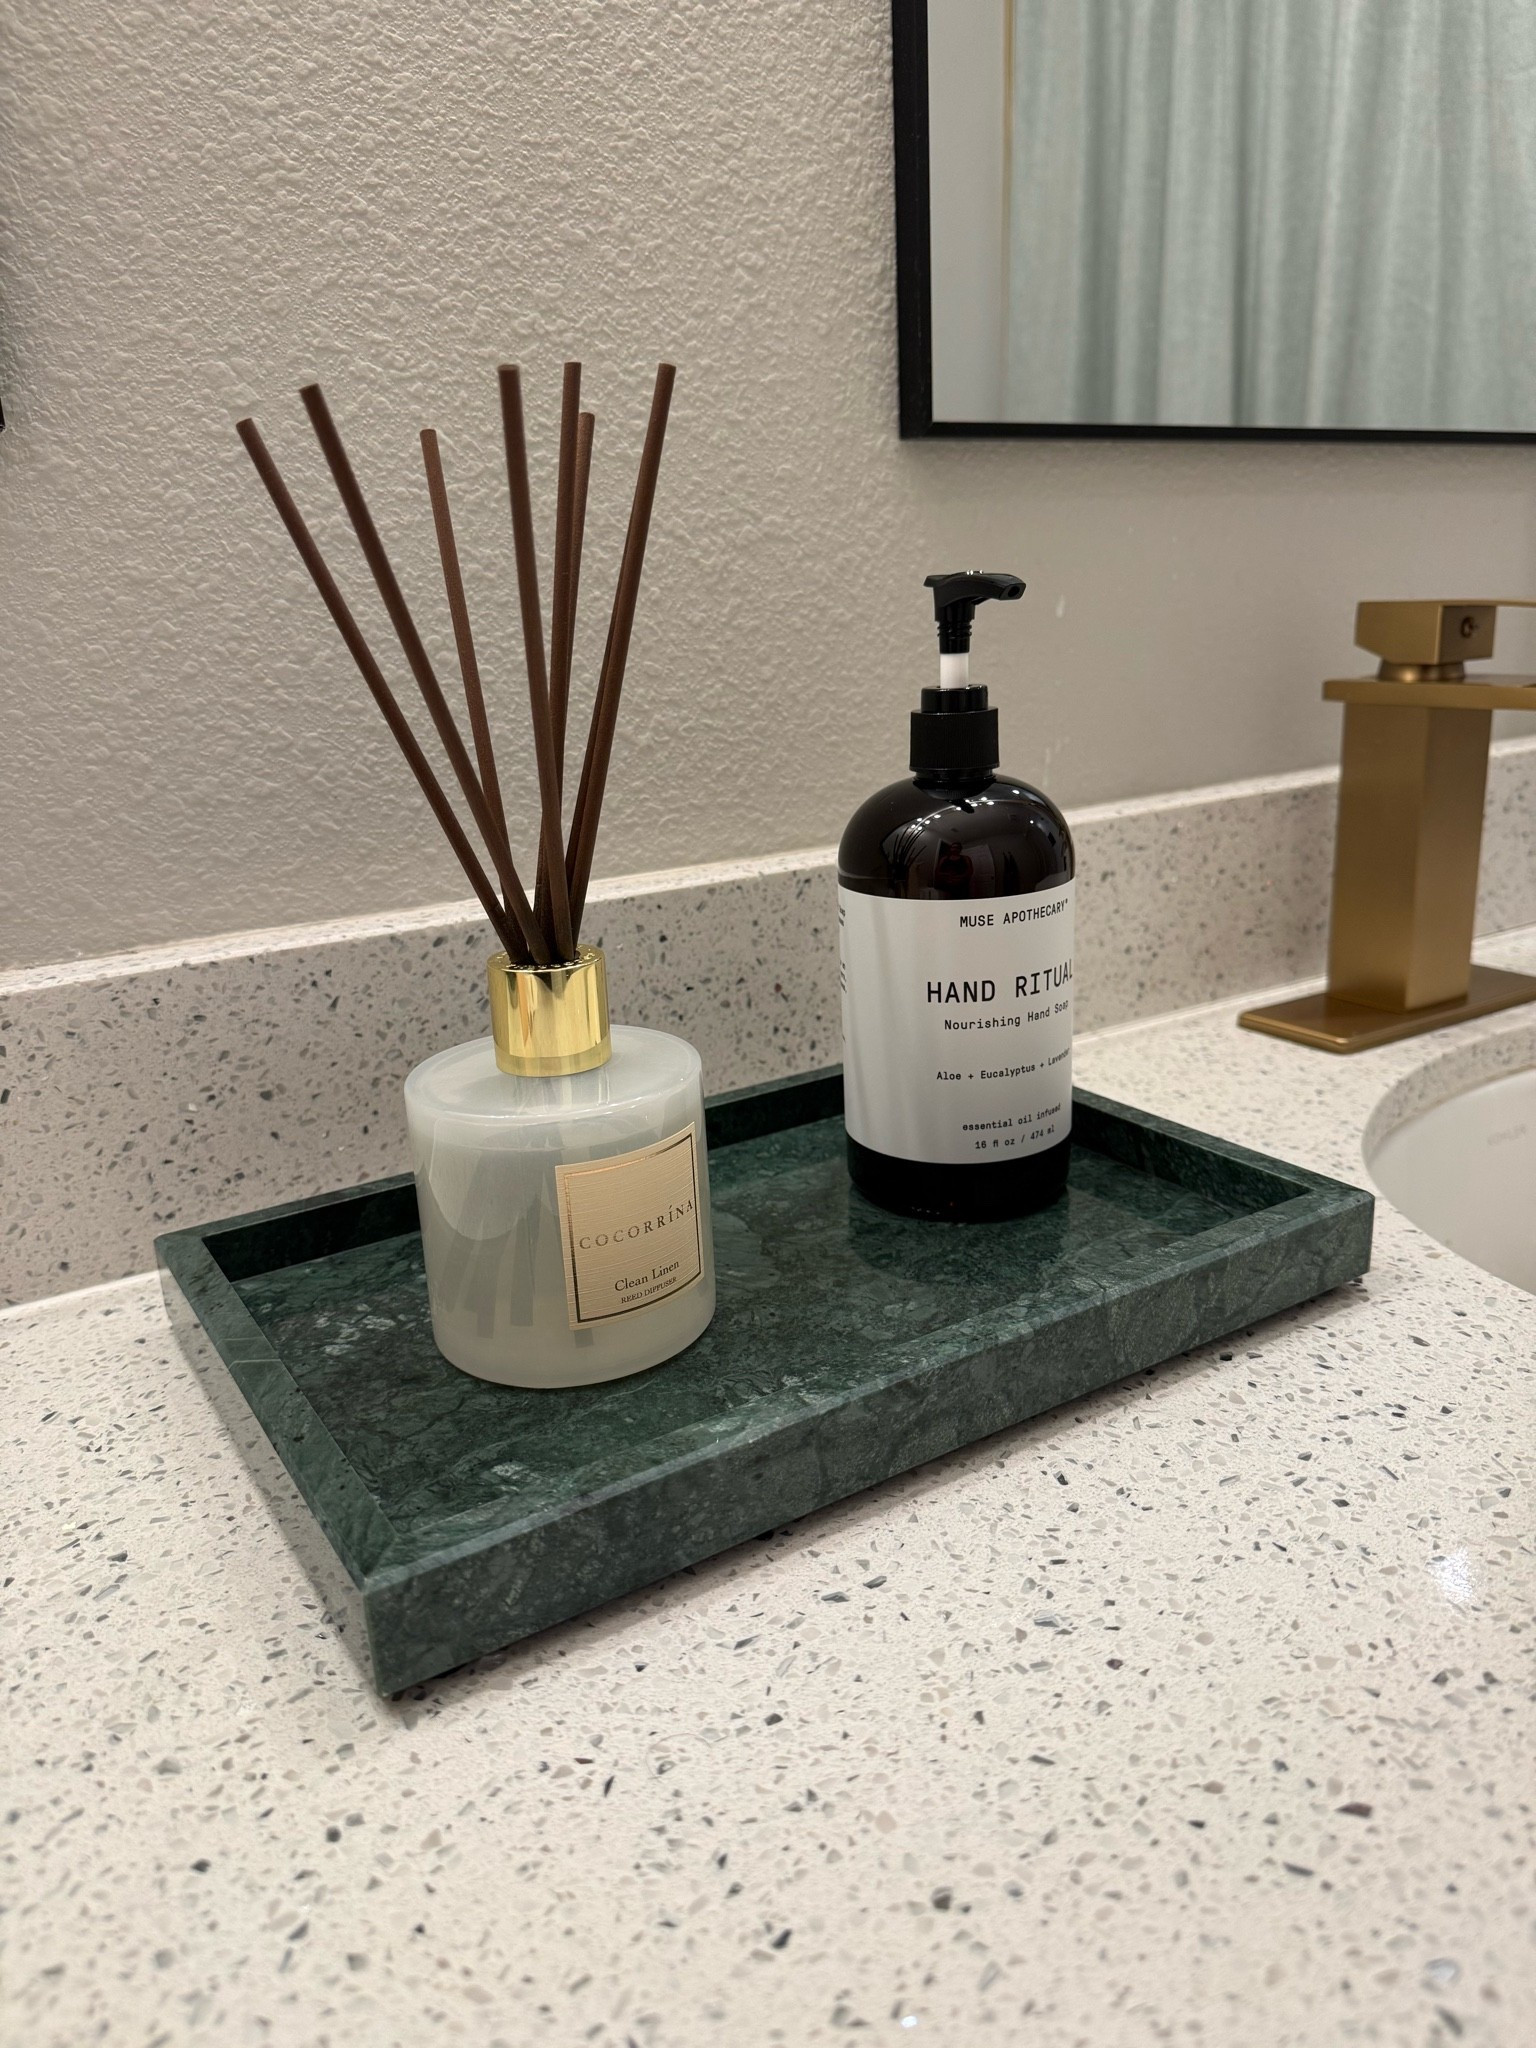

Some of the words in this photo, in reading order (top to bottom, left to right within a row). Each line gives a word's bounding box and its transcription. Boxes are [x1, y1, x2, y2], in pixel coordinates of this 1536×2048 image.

[960, 914, 994, 927] MUSE
[927, 980, 996, 1003] HAND
[1015, 958, 1073, 998] RITUAL
[944, 1016, 1021, 1030] Nourishing
[1027, 1007, 1050, 1022] Hand
[1054, 1000, 1069, 1014] Soap
[936, 1071, 962, 1080] Aloe
[980, 1064, 1035, 1079] Eucalyptus
[962, 1118, 1013, 1131] essential
[1017, 1114, 1032, 1125] oil
[1037, 1103, 1061, 1120] infused
[975, 1141, 987, 1149] 16
[1004, 1138, 1015, 1146] oz
[1030, 1129, 1044, 1140] 474
[579, 1199, 694, 1249] COCORRÍNA
[615, 1276, 649, 1291] Clean
[652, 1261, 680, 1280] Linen
[621, 1291, 643, 1303] REED
[644, 1276, 677, 1296] DIFFUSER
